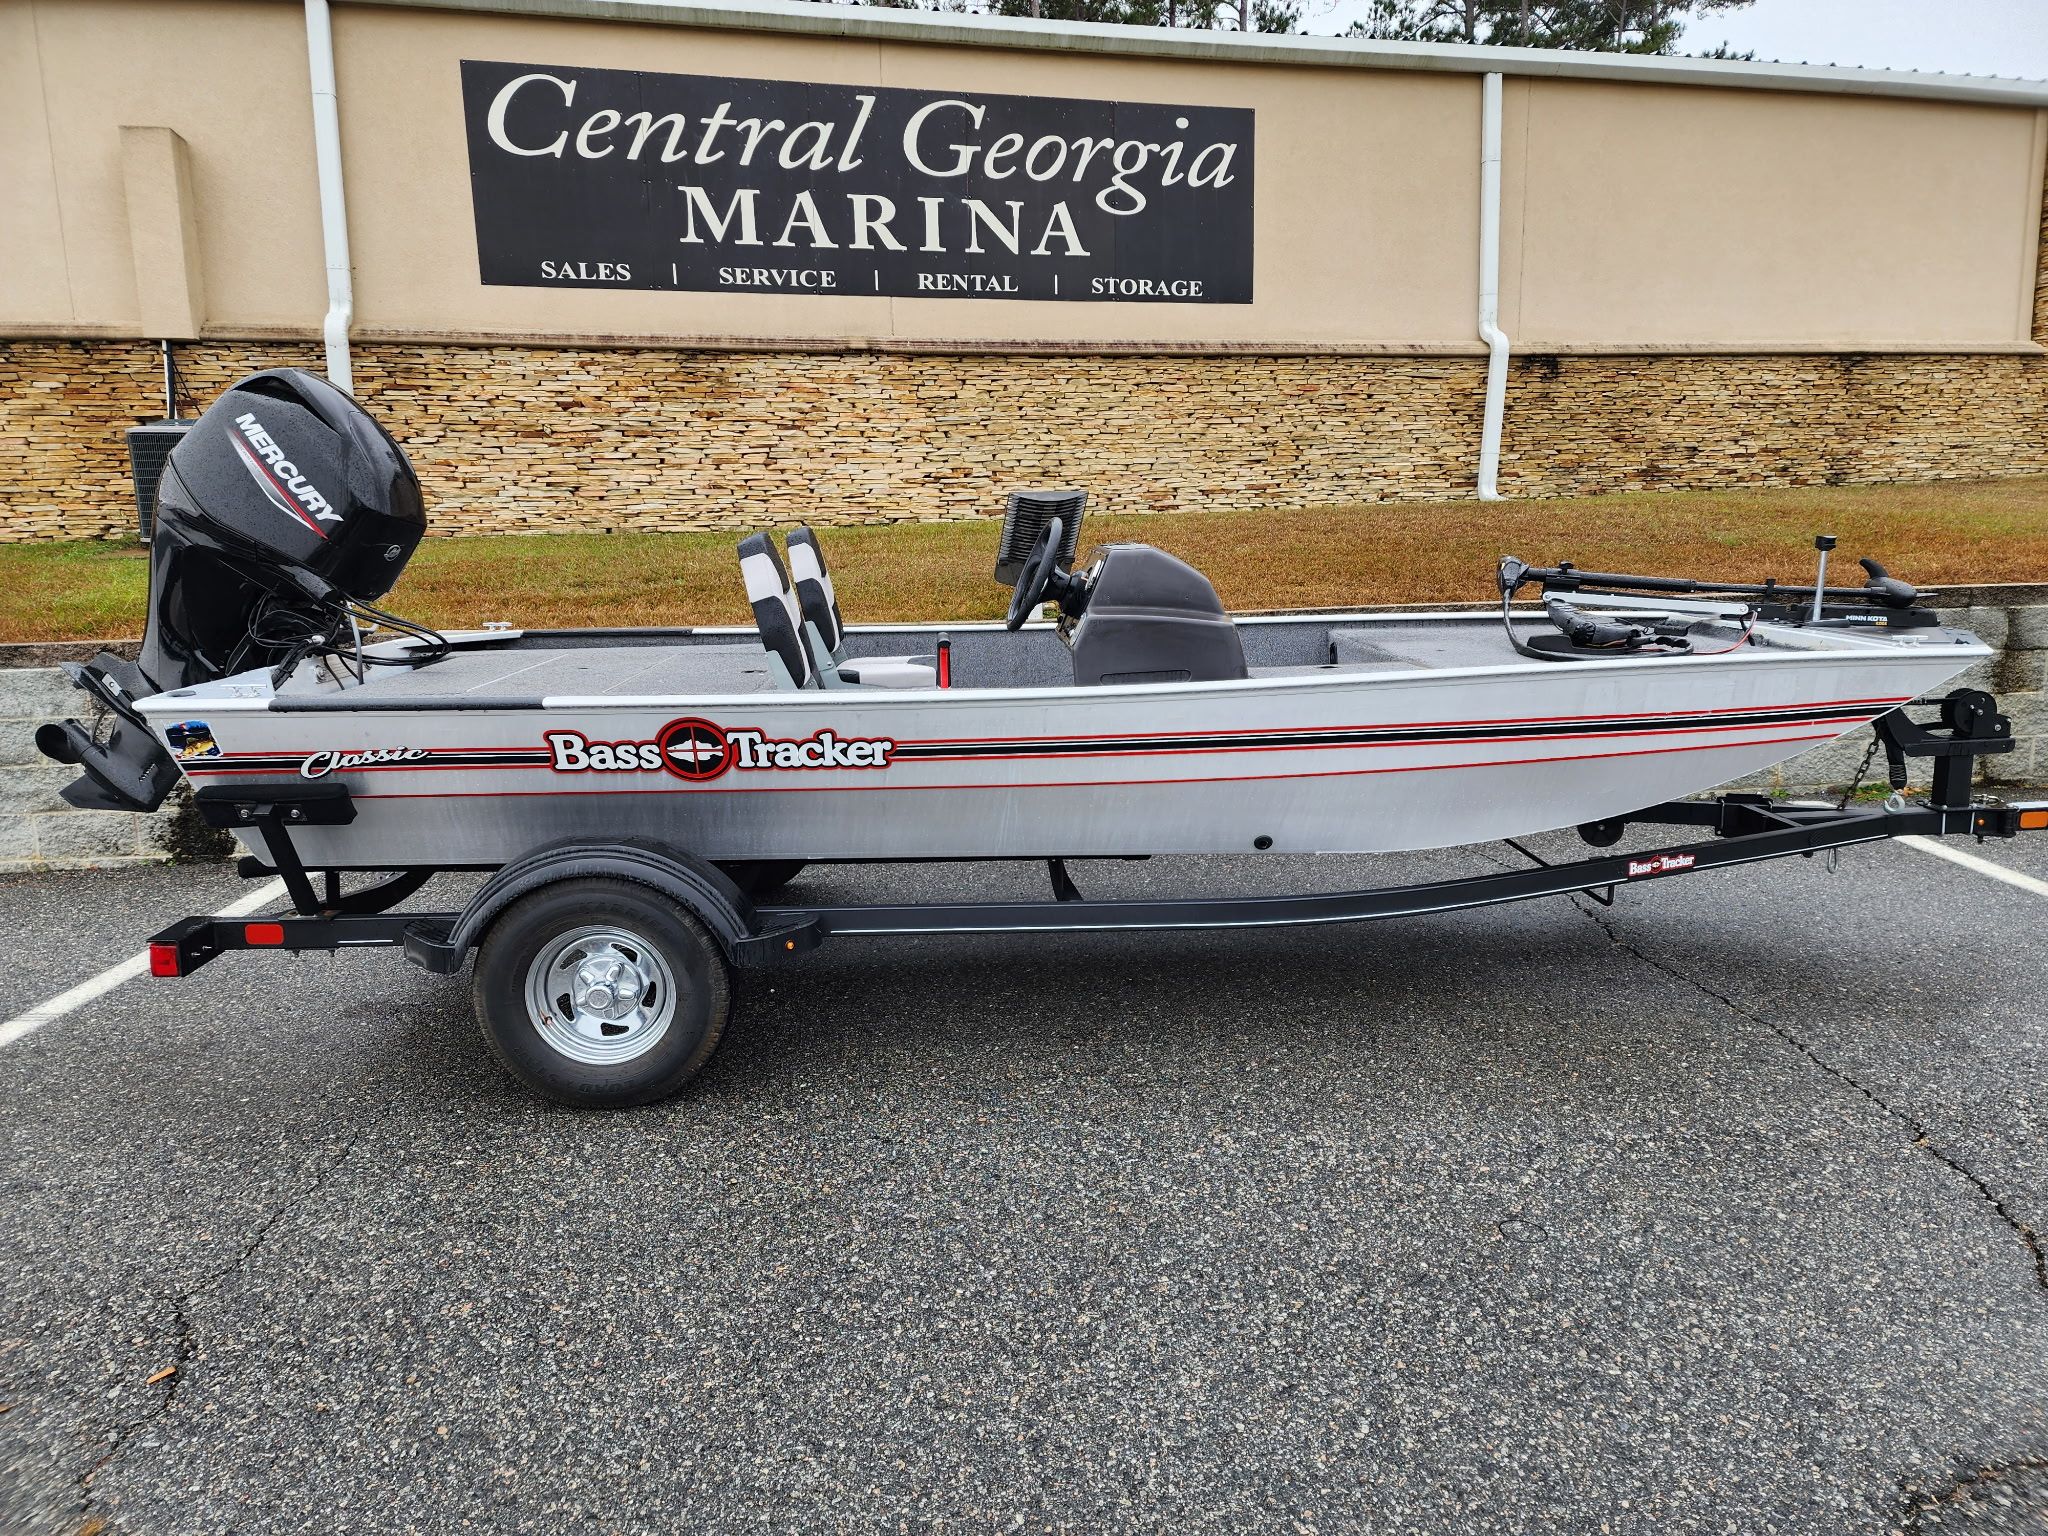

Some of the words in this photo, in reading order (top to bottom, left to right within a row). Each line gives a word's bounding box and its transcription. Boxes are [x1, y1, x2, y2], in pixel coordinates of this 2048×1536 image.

[487, 73, 875, 173] Central
[902, 99, 1238, 216] Georgia
[678, 186, 1091, 257] MARINA
[541, 260, 632, 281] SALES
[719, 267, 836, 288] SERVICE
[917, 273, 1019, 292] RENTAL
[1091, 277, 1204, 297] STORAGE
[235, 412, 344, 521] MERCURY
[1845, 614, 1867, 622] MINN
[300, 745, 429, 779] Classic
[549, 734, 663, 771] Bass
[726, 731, 892, 769] Tracker
[1628, 861, 1652, 876] Bass
[1660, 854, 1695, 870] Tracker
